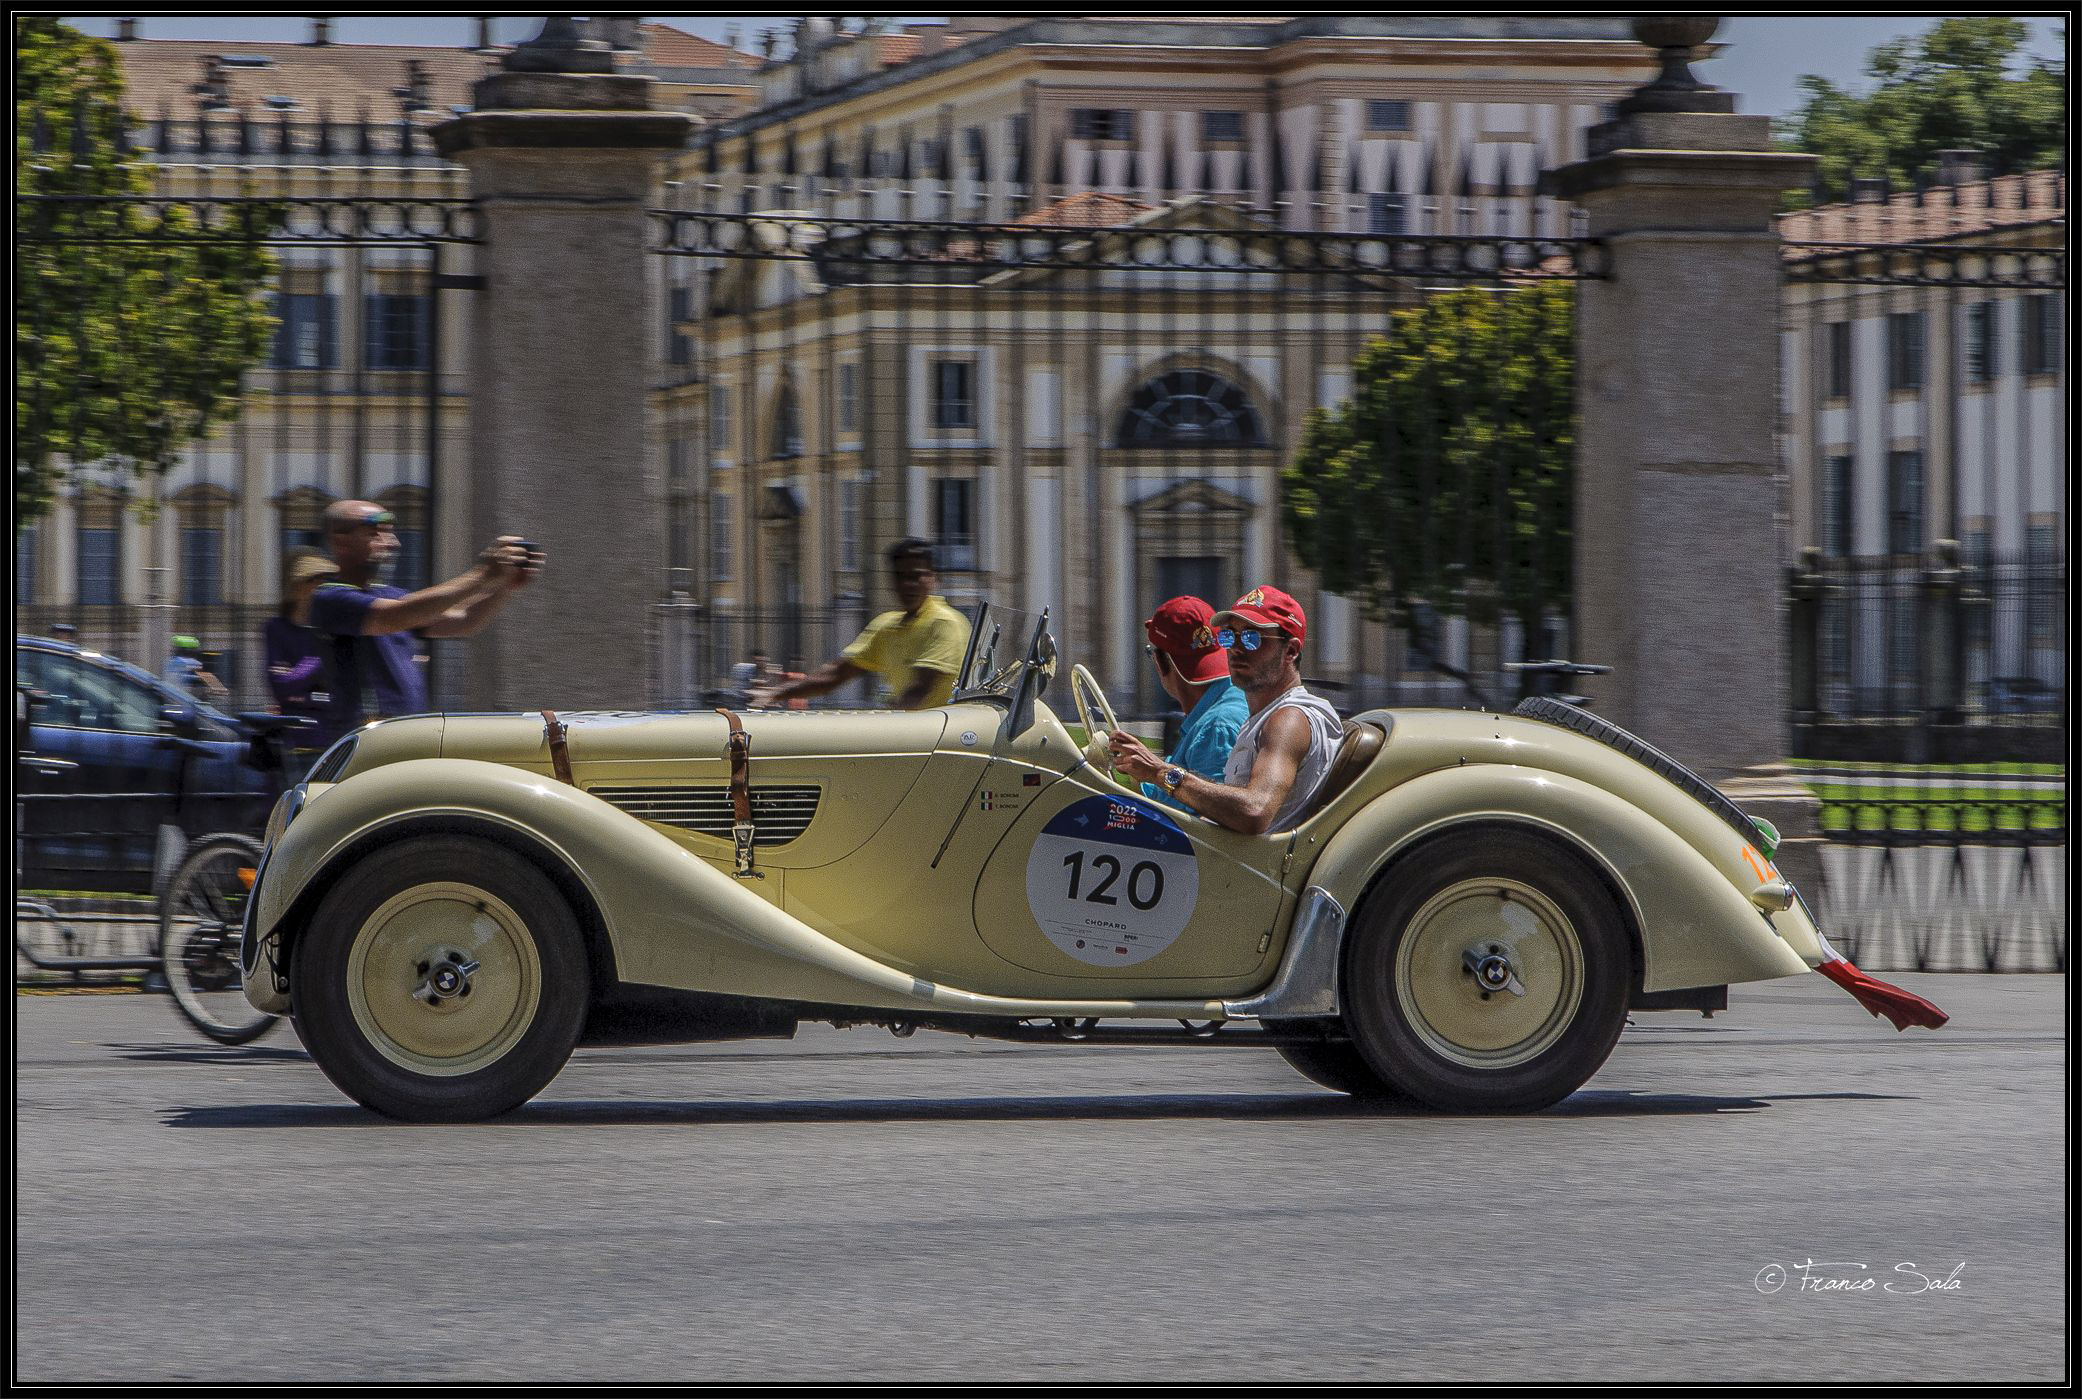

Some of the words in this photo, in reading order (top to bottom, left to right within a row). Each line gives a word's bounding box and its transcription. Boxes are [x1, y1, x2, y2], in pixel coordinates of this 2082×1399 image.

[1109, 803, 1137, 817] 2022
[1107, 821, 1135, 830] MIGLIA
[1063, 850, 1165, 911] 120
[1085, 919, 1127, 930] CHOPARD
